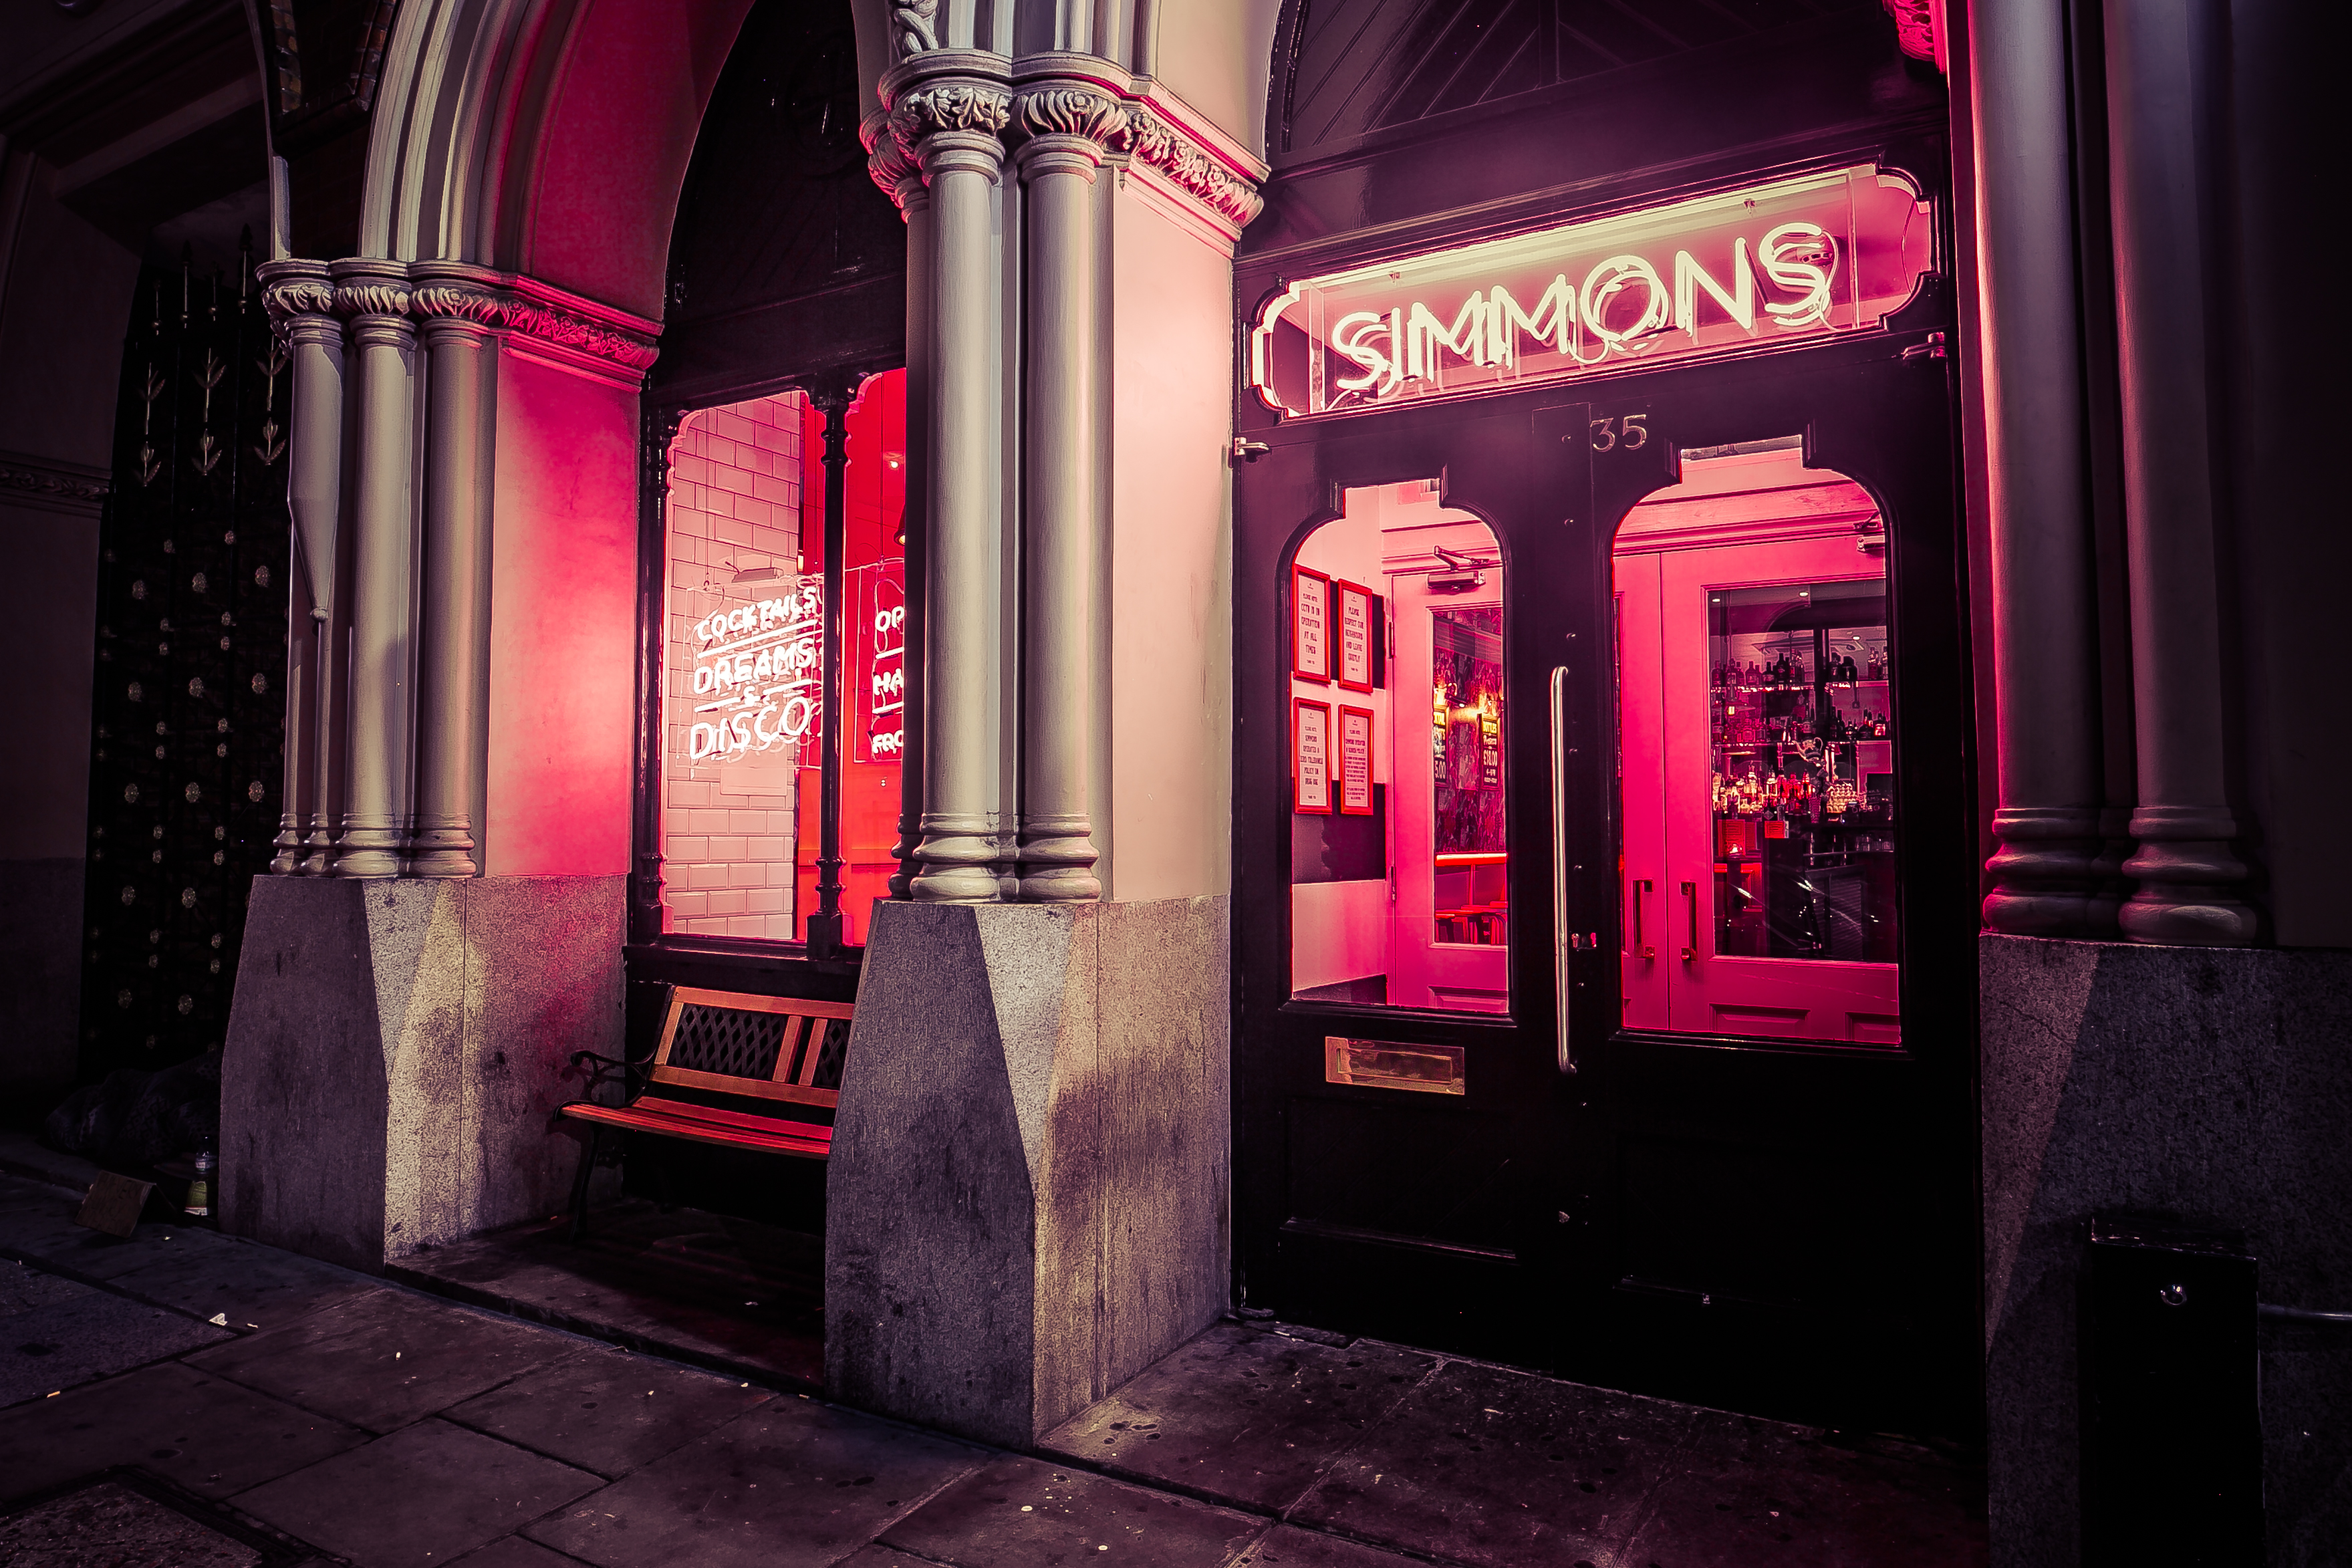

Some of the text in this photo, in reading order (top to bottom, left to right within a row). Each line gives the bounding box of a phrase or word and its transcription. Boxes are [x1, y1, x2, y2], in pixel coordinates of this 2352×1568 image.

[1331, 221, 1837, 392] SIMMONS
[1590, 414, 1647, 452] 35
[696, 586, 817, 642] COCKTAILS
[1301, 616, 1320, 629] OPERATION
[693, 638, 813, 694] DREAMS
[742, 685, 761, 709] &
[690, 696, 811, 761] DISCO
[1482, 721, 1496, 734] BOTTLES
